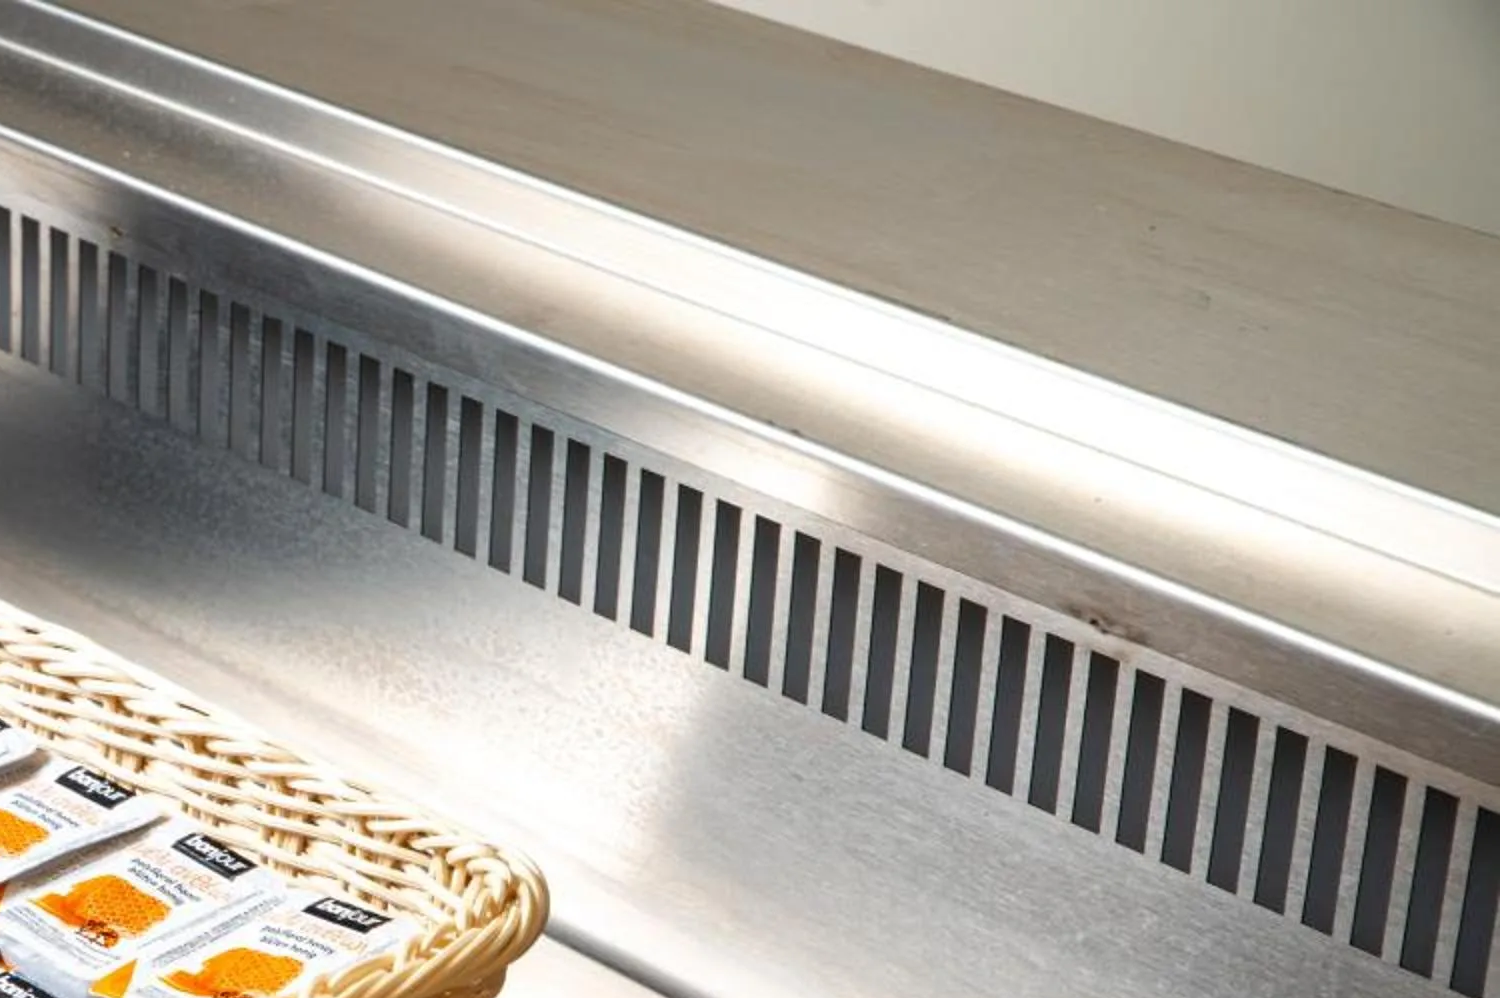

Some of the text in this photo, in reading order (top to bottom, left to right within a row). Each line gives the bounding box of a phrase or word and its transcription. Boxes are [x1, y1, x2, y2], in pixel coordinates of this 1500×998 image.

[68, 770, 126, 801] bonjour
[184, 836, 247, 871] bonjour
[314, 900, 381, 925] bonjour
